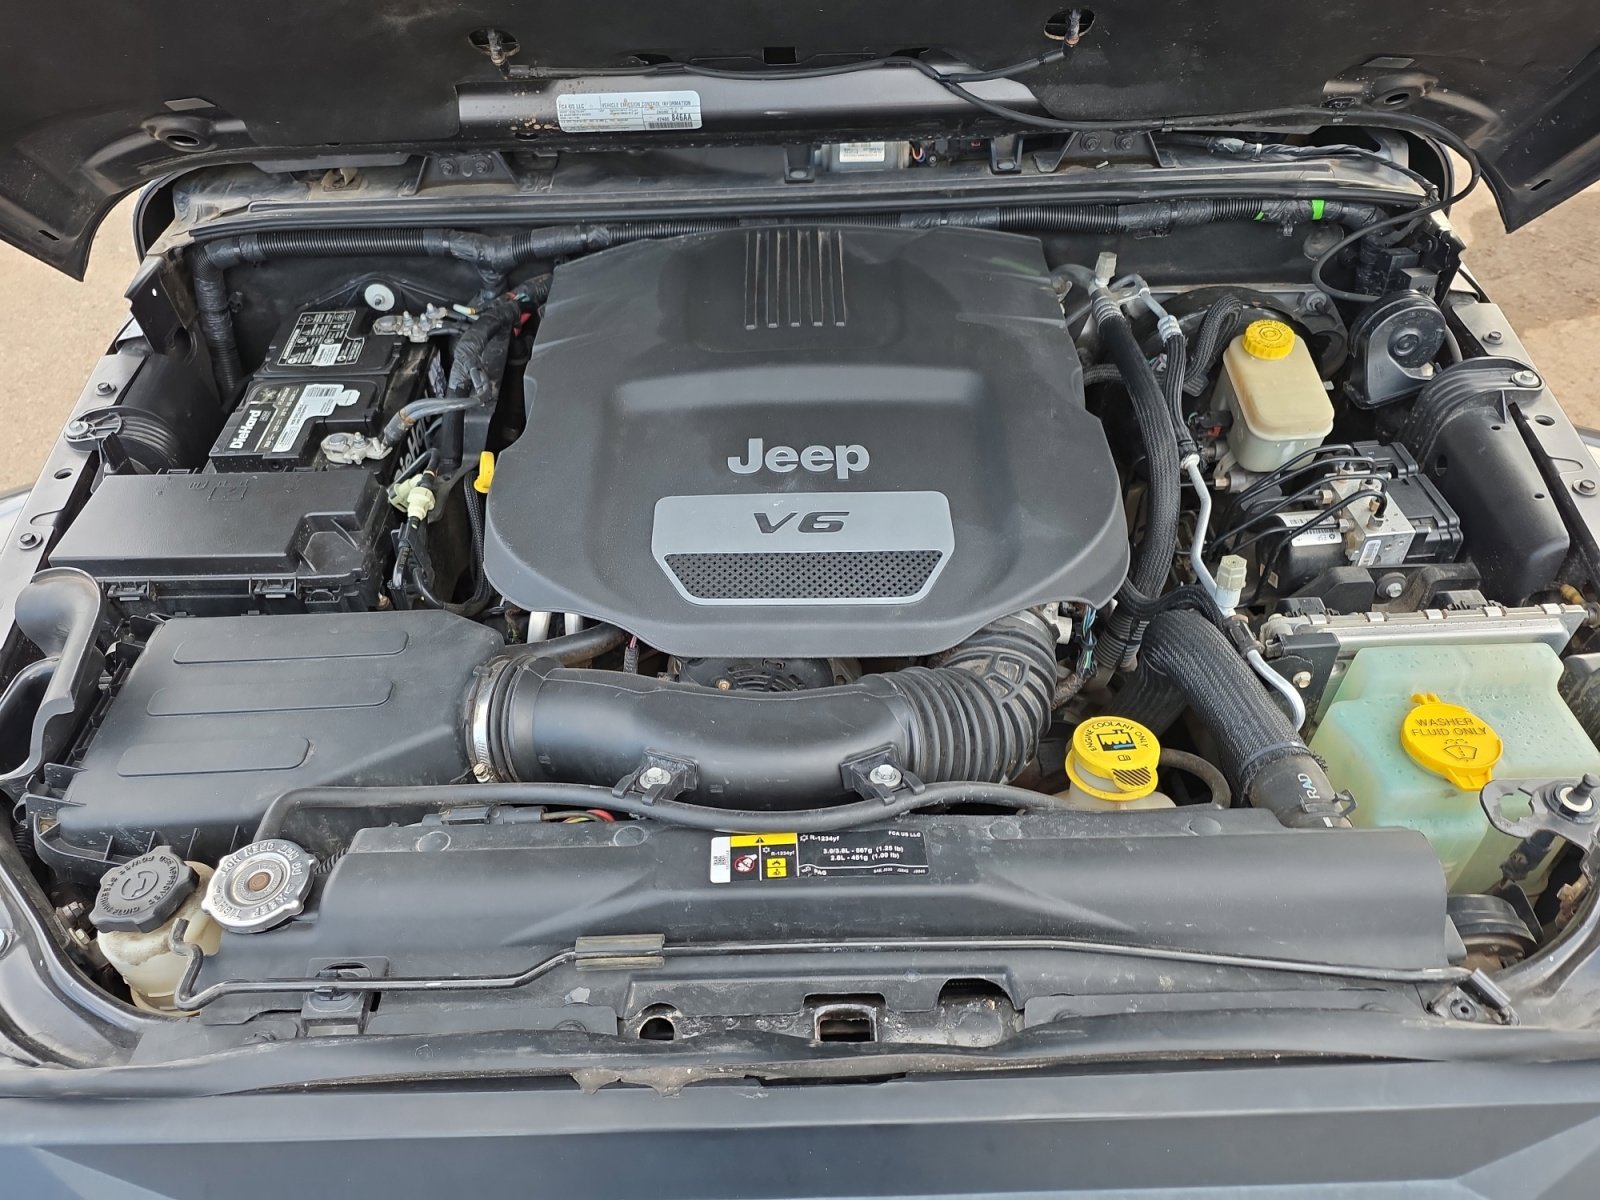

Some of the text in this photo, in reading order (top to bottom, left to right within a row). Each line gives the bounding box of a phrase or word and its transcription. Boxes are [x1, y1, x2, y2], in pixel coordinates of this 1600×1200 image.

[229, 409, 262, 449] DieHard
[727, 438, 870, 479] Jeep
[753, 511, 850, 534] V6
[1411, 727, 1487, 736] FLUID ONLY
[1415, 717, 1474, 726] WASHER
[1084, 721, 1149, 752] ENGINE COOLANT ONLY
[1297, 773, 1320, 799] RAD
[244, 842, 275, 857] OPEN
[809, 834, 840, 842] R-1234yf
[119, 855, 155, 876] POWER
[148, 865, 177, 905] APPROVED
